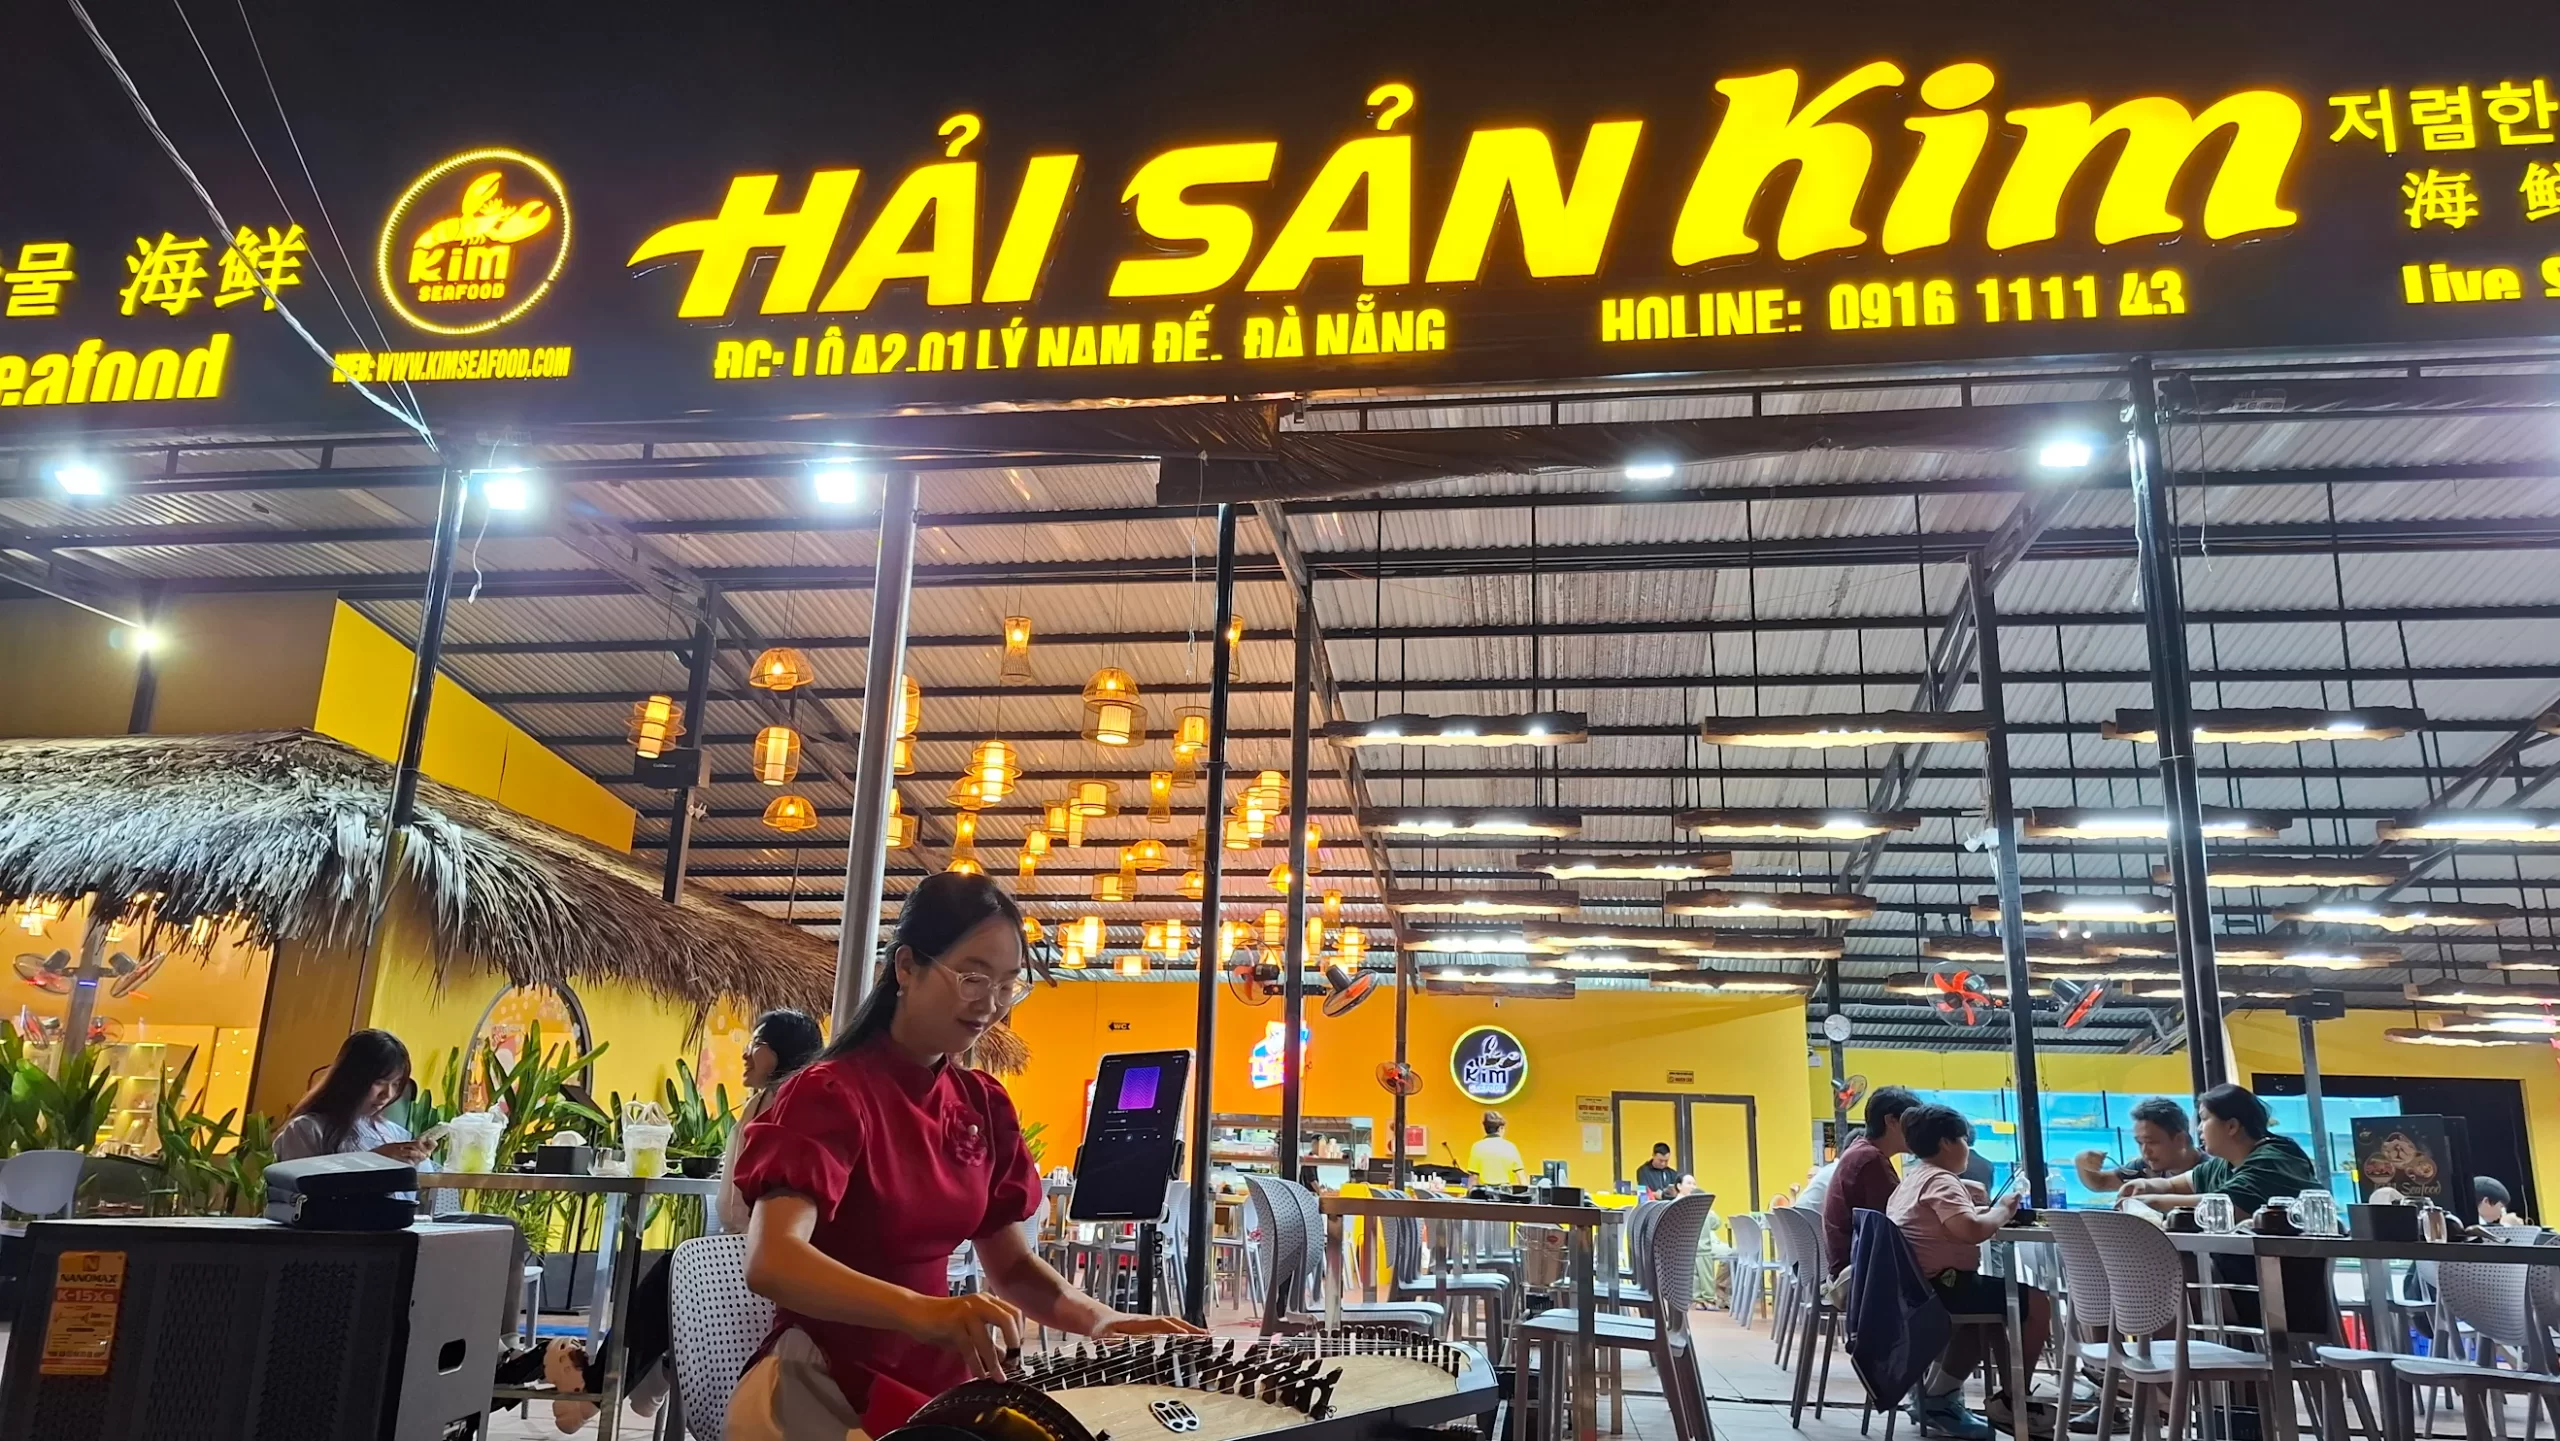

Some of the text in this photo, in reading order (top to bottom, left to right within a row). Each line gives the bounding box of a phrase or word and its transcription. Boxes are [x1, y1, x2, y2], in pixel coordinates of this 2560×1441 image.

[2328, 79, 2559, 153] 저렴한
[627, 61, 2302, 318] HẢI SẢN Kim
[0, 224, 306, 317] 물 海鲜
[418, 283, 505, 302] SEAFOOD
[1829, 279, 1955, 330] 0916
[1976, 277, 2098, 323] 1111
[2118, 269, 2186, 317] 43
[977, 316, 1028, 370] LÝ
[1037, 324, 1140, 367] NAM
[1244, 305, 1304, 359] ĐÀ
[1316, 293, 1446, 356] NẴNG
[376, 347, 572, 382] WWW.KIMSEAFOOD.COM
[2401, 1181, 2442, 1196] Seafood
[60, 1273, 118, 1283] NANOMAX
